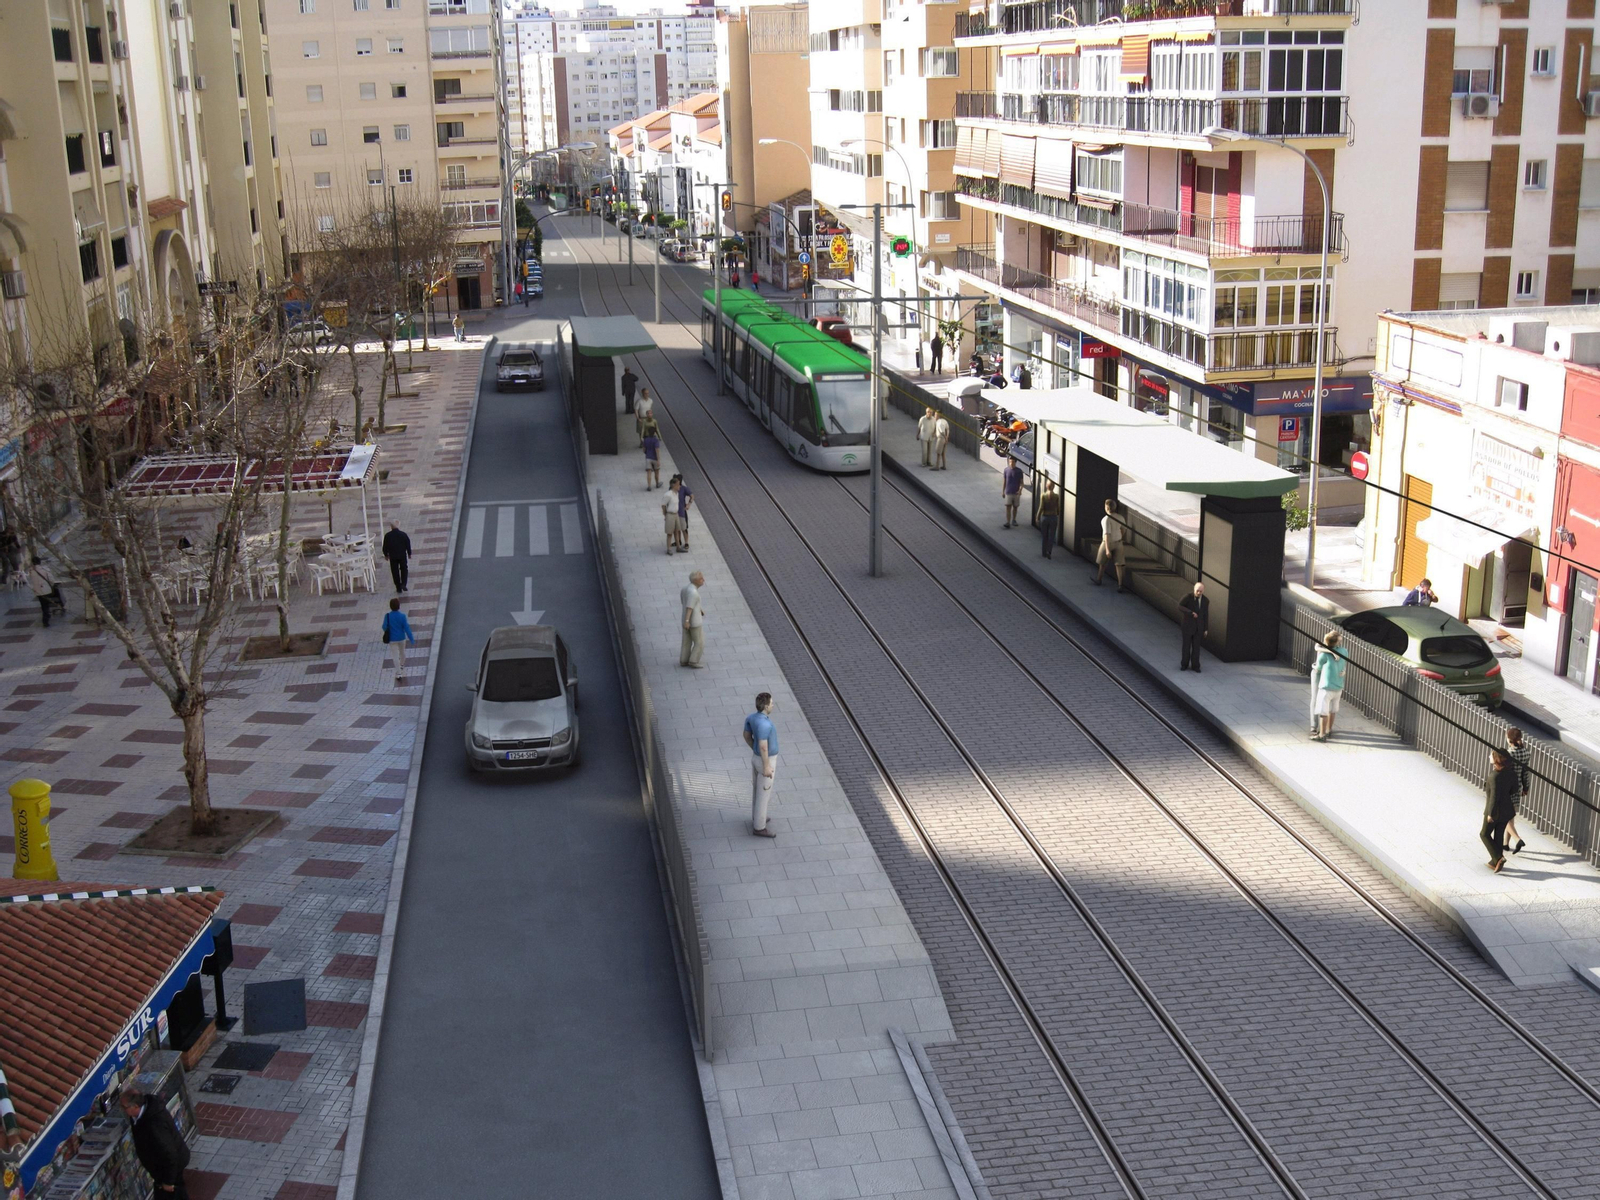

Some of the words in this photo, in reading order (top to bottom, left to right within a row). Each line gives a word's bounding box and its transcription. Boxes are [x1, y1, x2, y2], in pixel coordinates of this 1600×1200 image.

[1285, 419, 1293, 430] P
[17, 808, 30, 864] CORREOS
[117, 1006, 155, 1062] SUR
